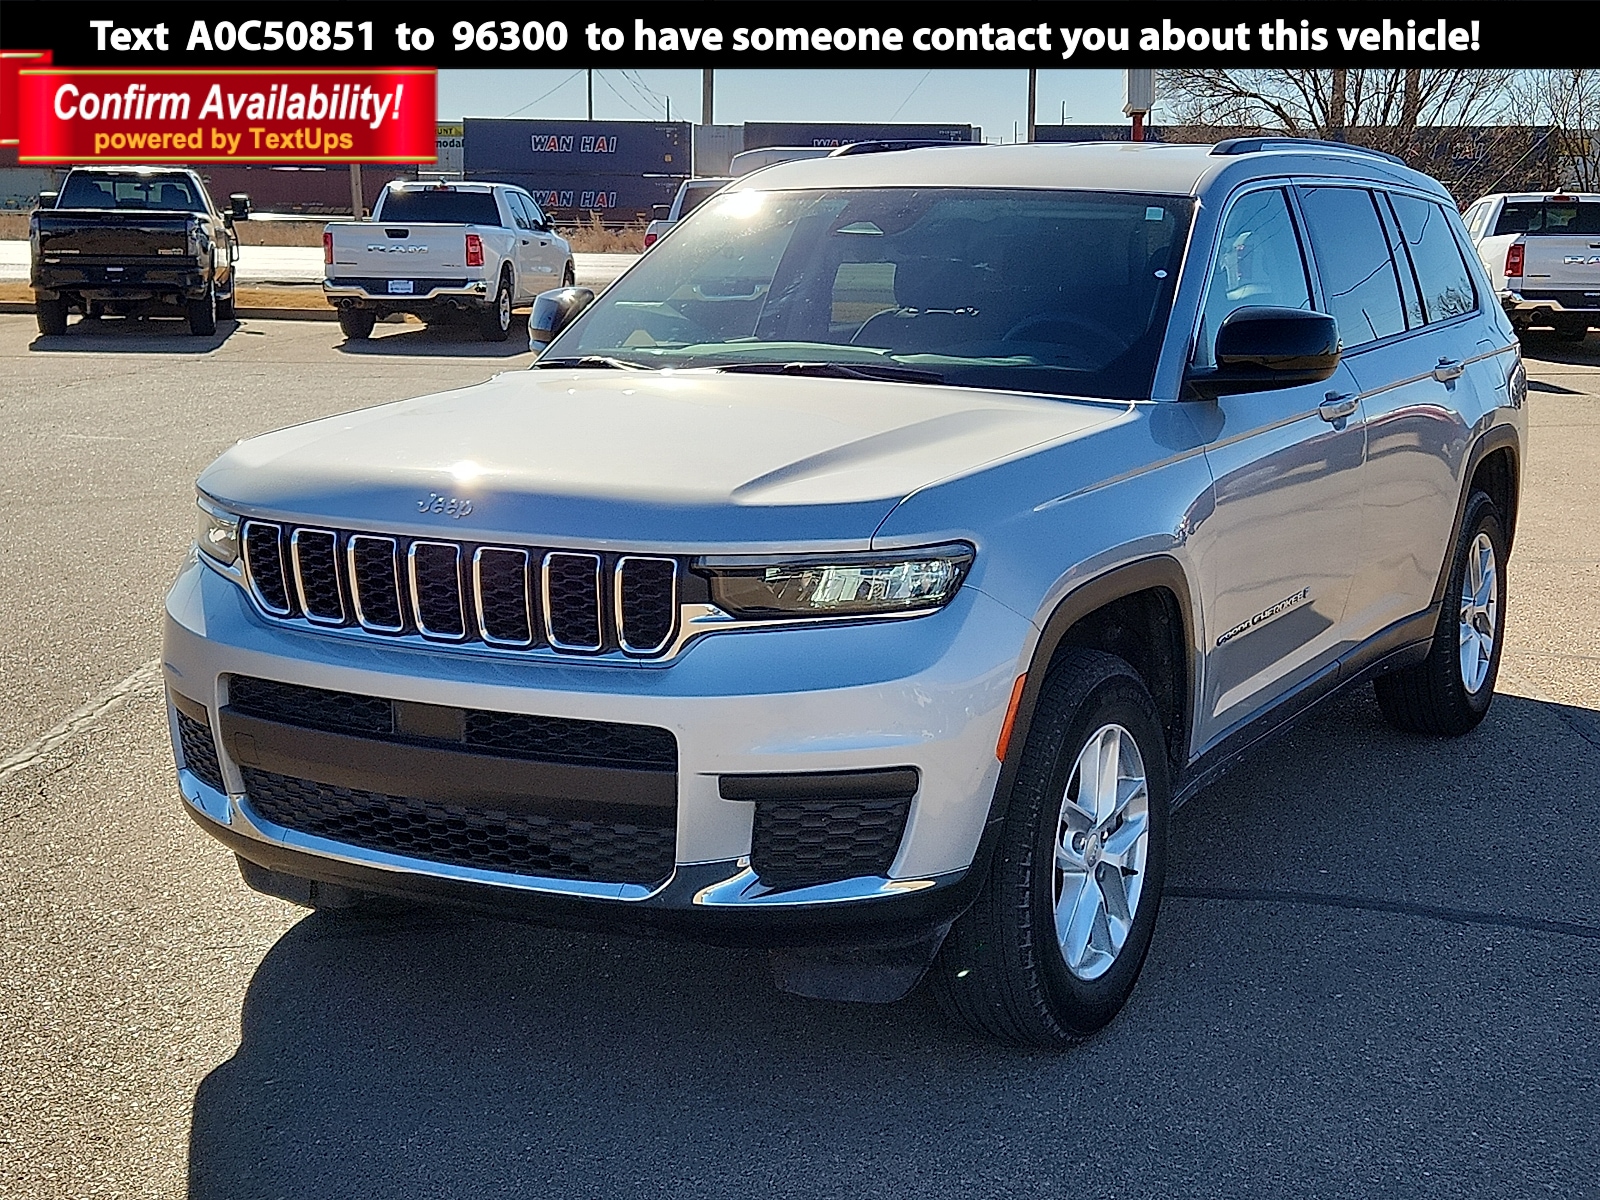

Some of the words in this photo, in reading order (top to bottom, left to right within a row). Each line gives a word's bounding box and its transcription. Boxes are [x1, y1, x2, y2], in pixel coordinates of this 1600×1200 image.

[531, 135, 574, 152] WAN
[580, 135, 617, 153] HAI
[532, 190, 574, 207] WAN
[580, 191, 617, 208] HAI
[367, 243, 429, 254] RAM
[1563, 255, 1600, 265] RA
[416, 491, 474, 520] Jeep
